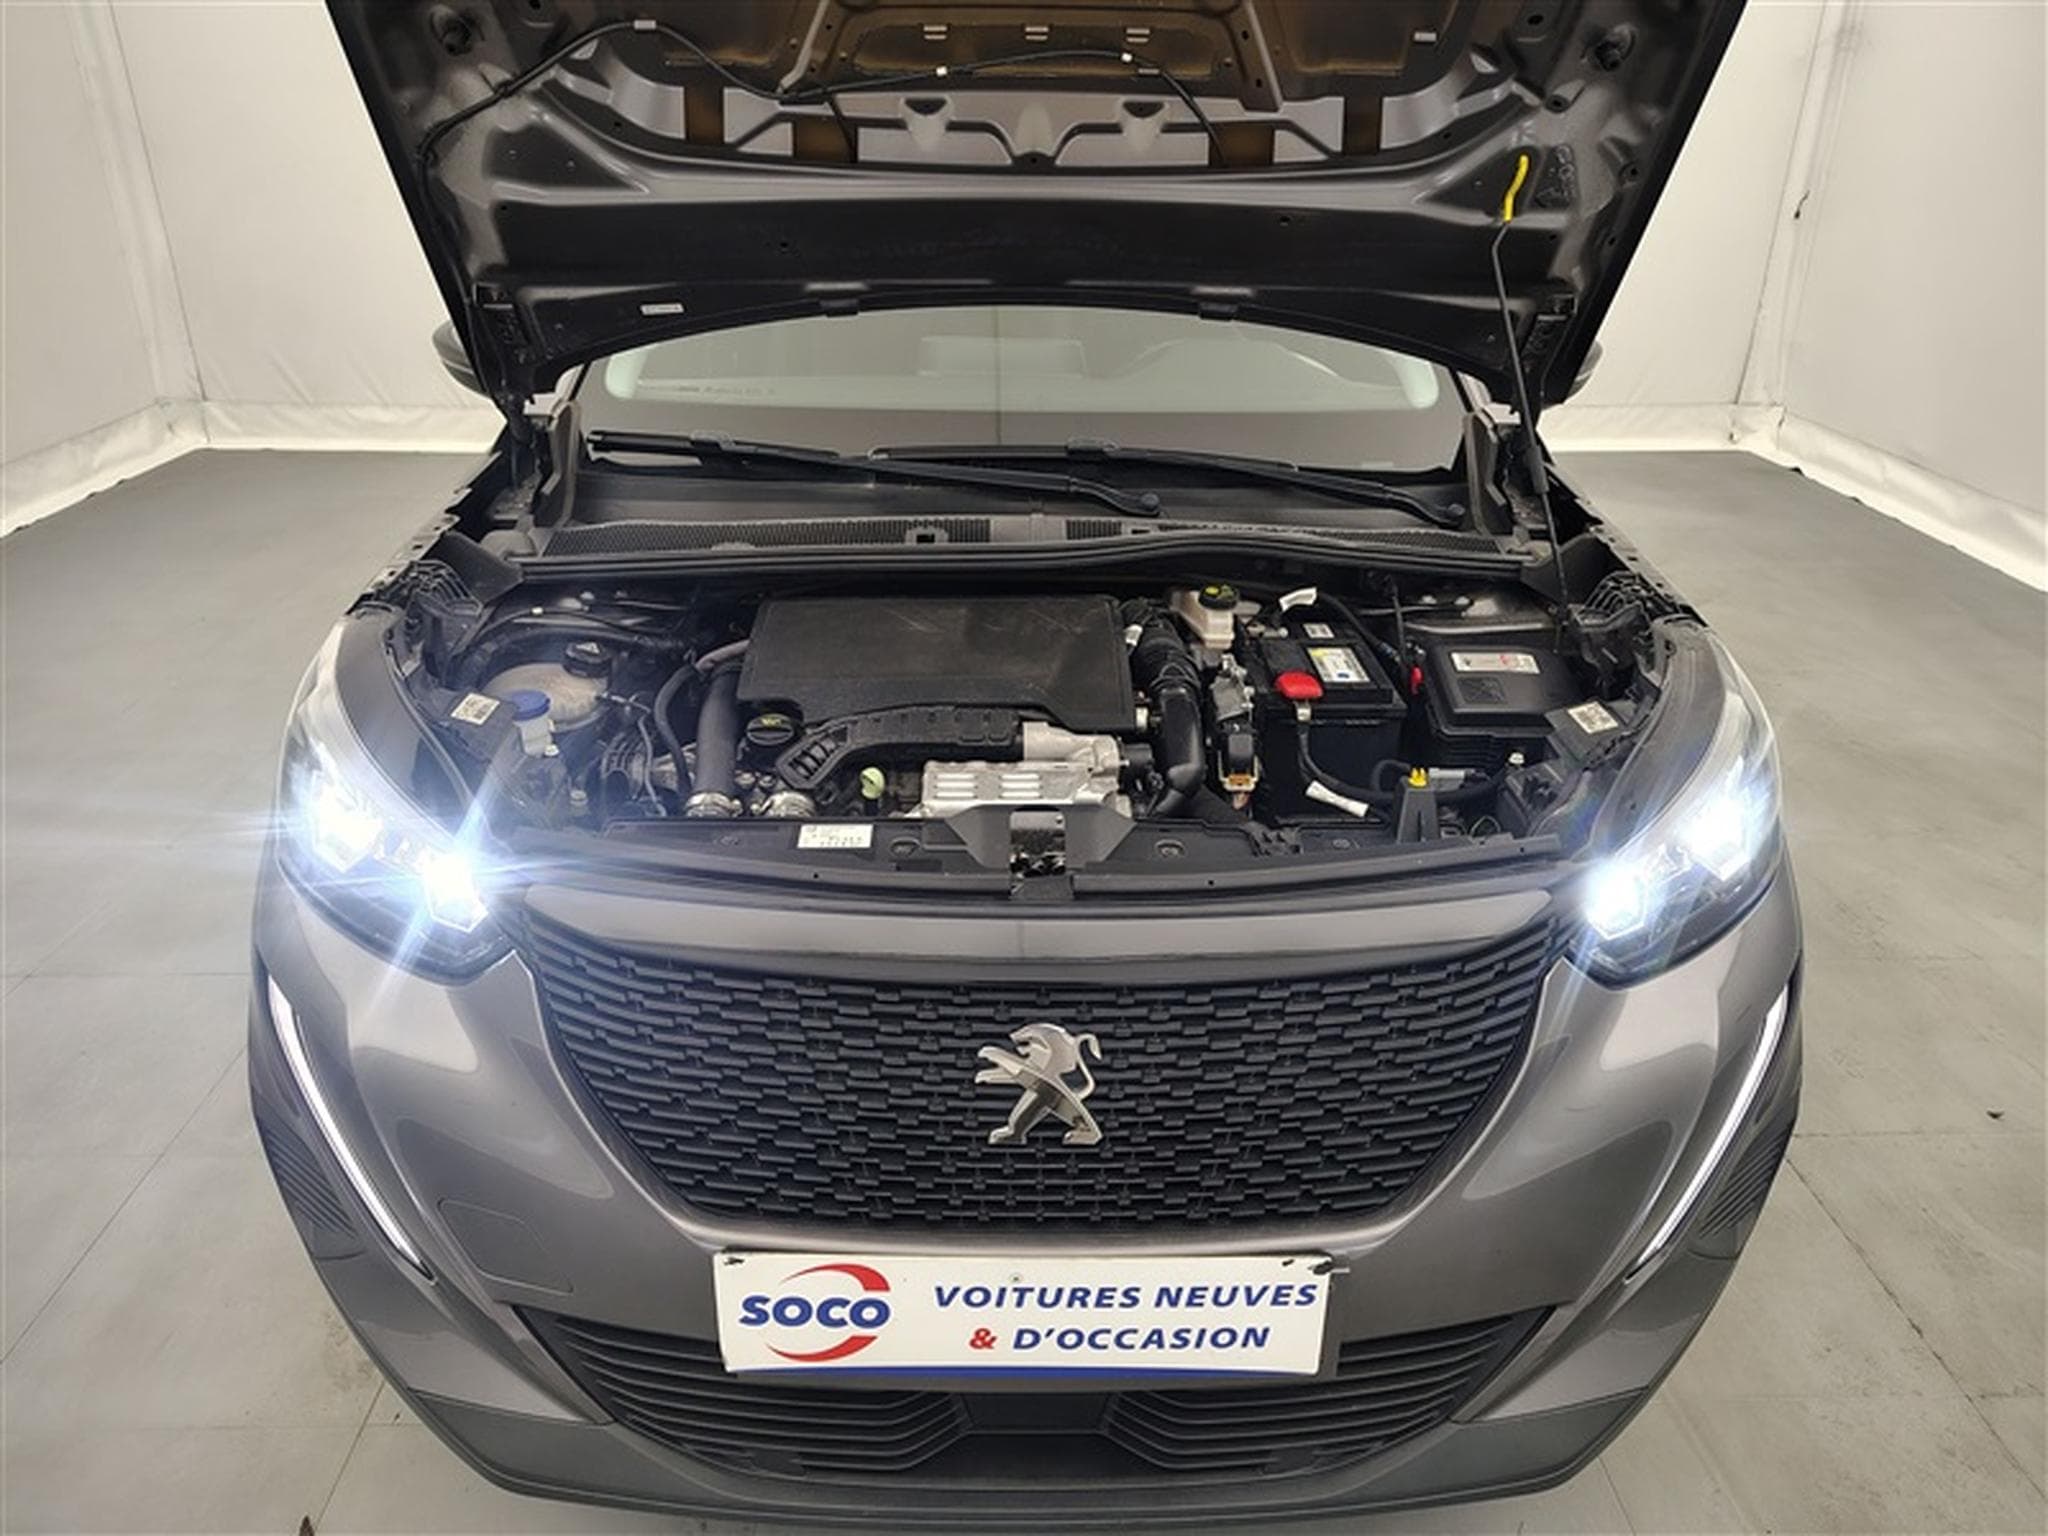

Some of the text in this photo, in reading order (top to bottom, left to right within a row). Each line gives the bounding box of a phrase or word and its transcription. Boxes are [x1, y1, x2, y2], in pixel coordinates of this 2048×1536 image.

[935, 1284, 1319, 1308] VOITURES NEUVES
[739, 1295, 891, 1329] SOCO
[969, 1327, 1271, 1350] & D'OCCASION
